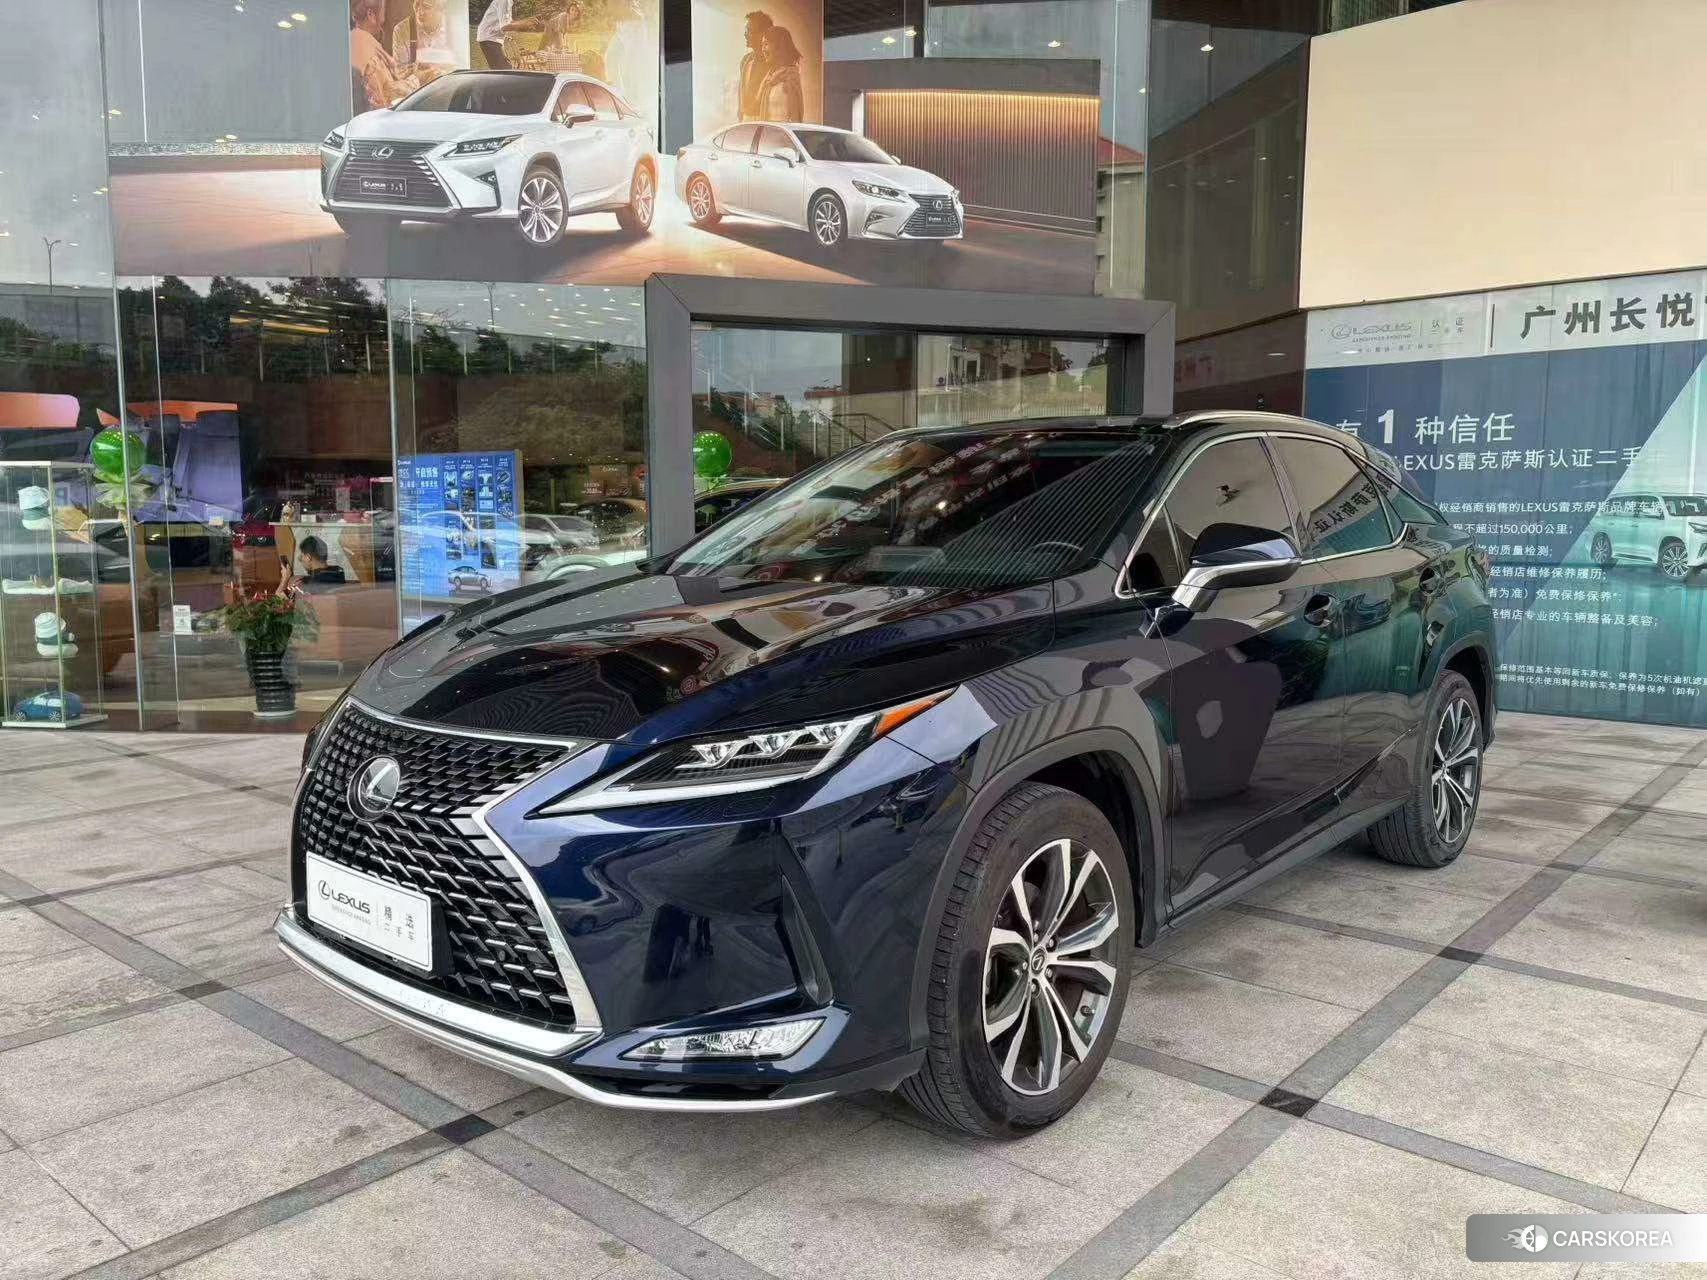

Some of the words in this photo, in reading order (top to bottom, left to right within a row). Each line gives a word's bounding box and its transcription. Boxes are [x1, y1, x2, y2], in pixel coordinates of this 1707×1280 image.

[1520, 292, 1707, 340] 广州长悦
[1378, 409, 1394, 444] 1
[1415, 412, 1516, 445] 种信任
[331, 889, 371, 914] LEXUS
